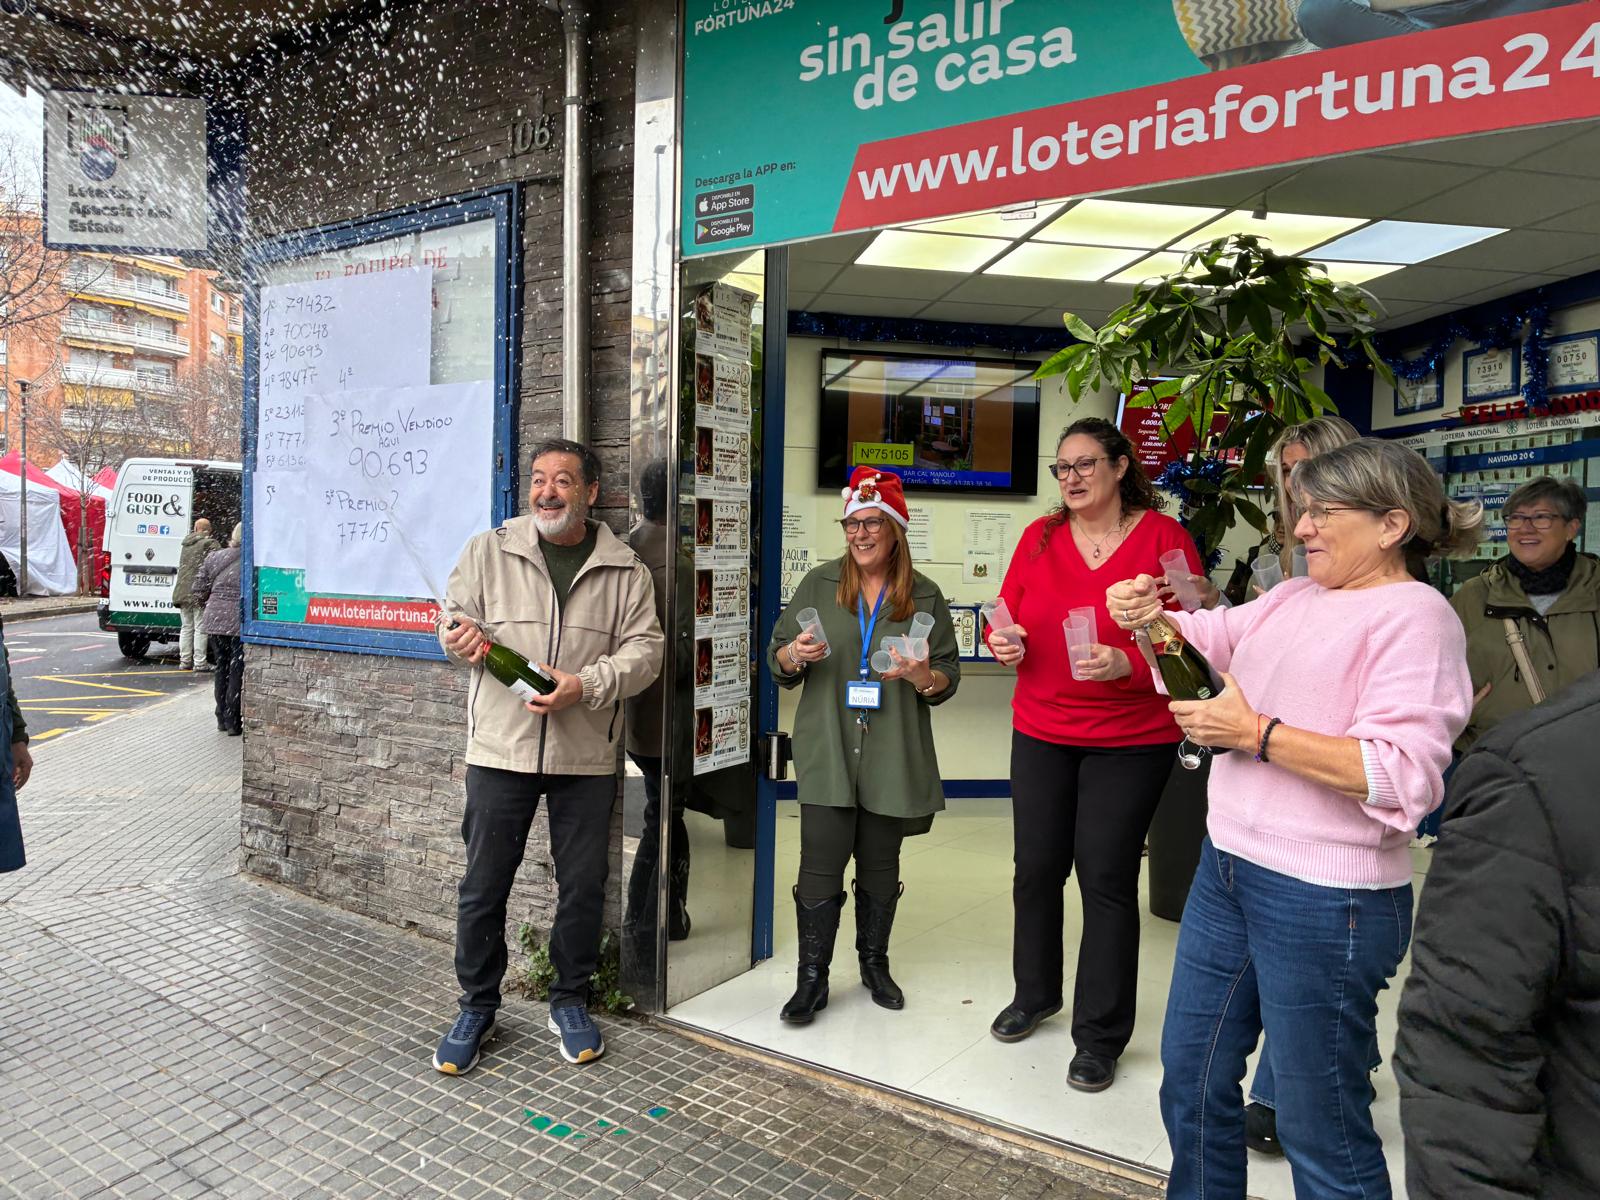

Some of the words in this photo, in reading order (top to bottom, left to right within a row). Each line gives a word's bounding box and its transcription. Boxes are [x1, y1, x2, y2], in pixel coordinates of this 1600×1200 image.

[694, 0, 795, 36] FORTUNA24
[799, 26, 871, 82] sin
[887, 0, 1014, 59] salir
[853, 55, 919, 110] de
[935, 26, 1077, 92] casa
[857, 21, 1600, 200] www.loteriafortuna24
[695, 171, 742, 188] Descarga
[744, 168, 752, 179] la
[755, 162, 778, 177] APP
[780, 161, 796, 172] en:
[711, 201, 727, 212] App
[728, 197, 750, 208] Store
[710, 225, 735, 236] Google
[736, 223, 751, 233] Play
[285, 294, 336, 314] 79432
[284, 322, 328, 340] 70048
[280, 343, 323, 363] 90693
[1477, 363, 1503, 375] 73910
[1464, 400, 1527, 424] FELIZ
[1550, 417, 1580, 427] NACIONAL
[330, 409, 346, 437] 3º
[1441, 431, 1465, 441] LOTERIA
[1467, 427, 1500, 438] NACIONAL
[349, 447, 429, 479] 90.693
[861, 448, 909, 461] Nº75105
[1488, 454, 1518, 464] NAVIDAD
[1519, 452, 1528, 460] 20
[127, 492, 163, 504] FOOD
[127, 504, 161, 516] GUST
[162, 494, 185, 517] &
[337, 521, 391, 544] 77715
[789, 562, 812, 573] JUEVES
[131, 575, 152, 583] 2104
[155, 576, 170, 584] MXL
[310, 603, 439, 624] www.loteriafortuna2
